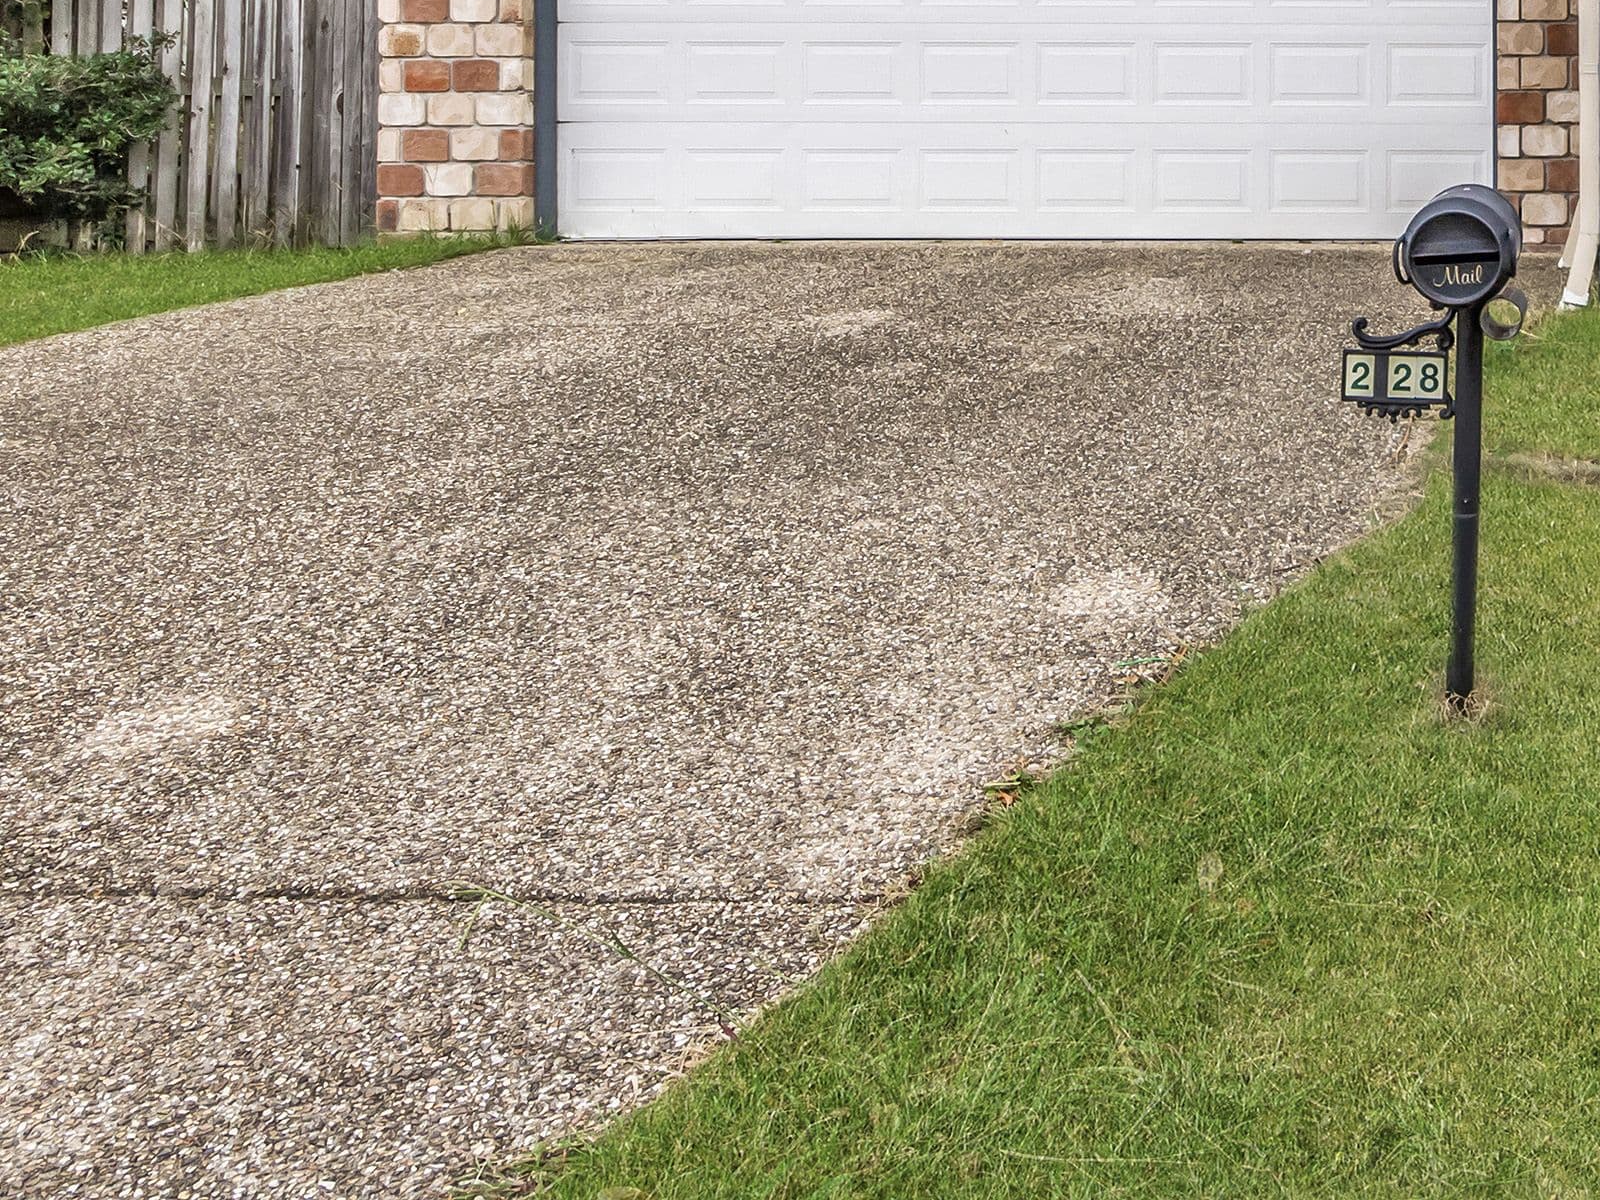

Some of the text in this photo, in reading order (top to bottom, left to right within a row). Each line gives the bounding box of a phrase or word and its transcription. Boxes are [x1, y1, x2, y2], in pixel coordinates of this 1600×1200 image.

[1432, 264, 1484, 288] Mail
[1351, 362, 1439, 393] 2 28
